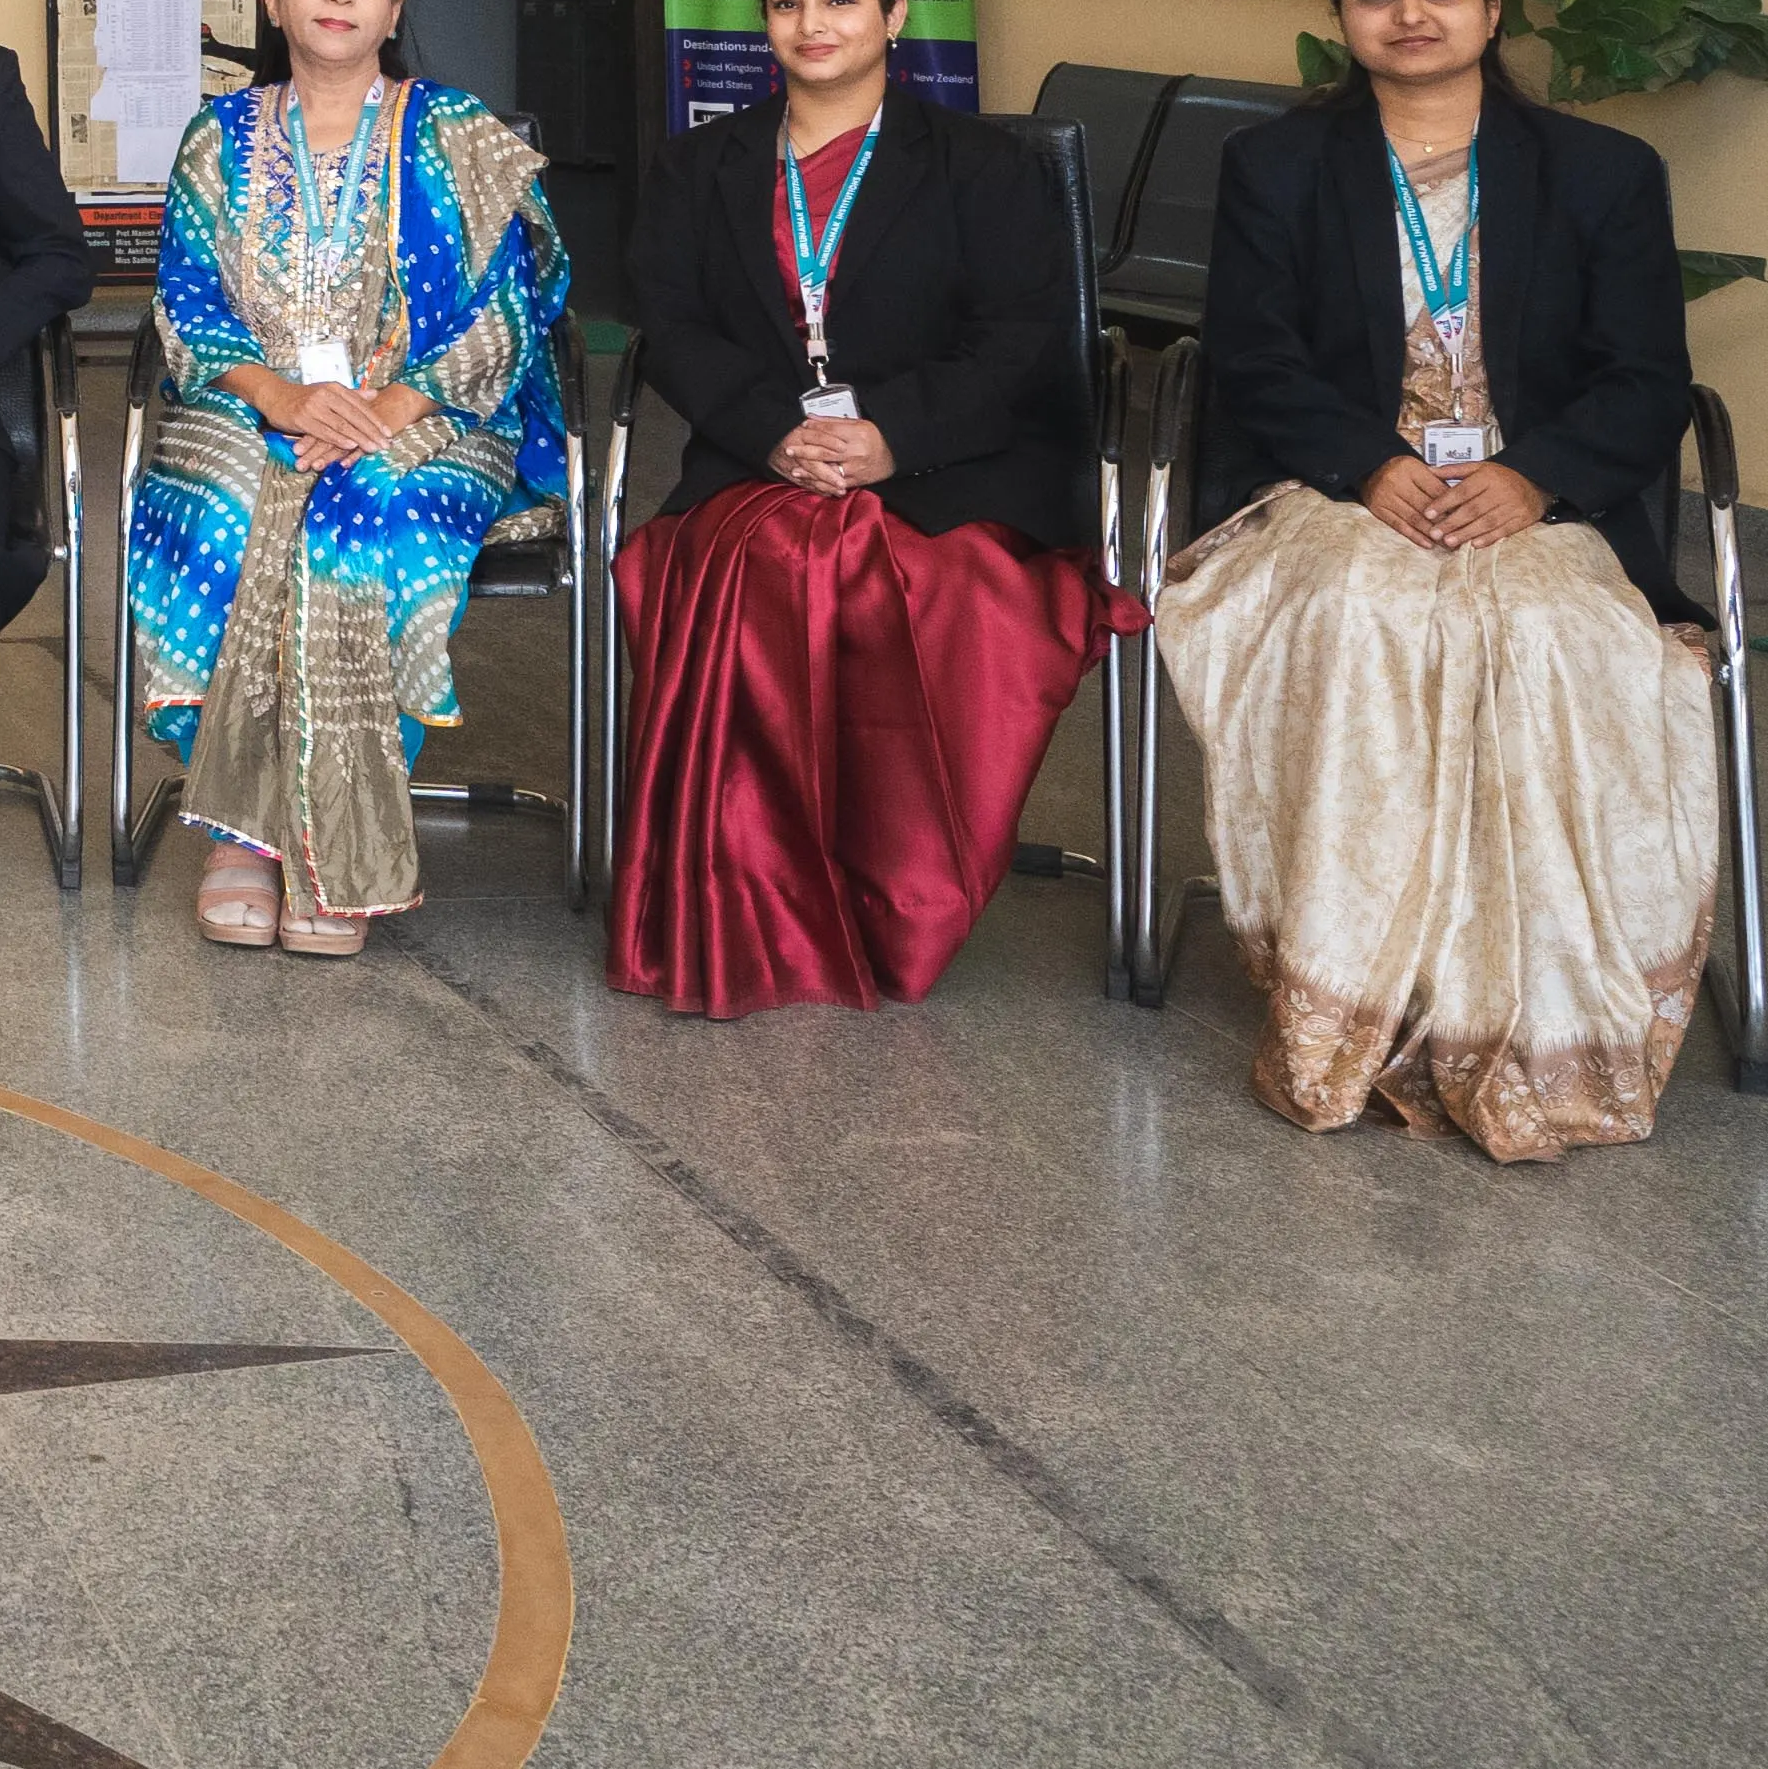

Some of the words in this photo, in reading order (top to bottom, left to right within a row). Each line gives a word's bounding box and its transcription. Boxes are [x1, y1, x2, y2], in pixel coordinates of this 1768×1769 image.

[683, 39, 747, 52] Destinations
[749, 43, 768, 52] and
[696, 61, 723, 72] United
[725, 64, 763, 75] Kingdom
[697, 79, 723, 89] United
[725, 81, 753, 90] States
[913, 72, 934, 83] New
[936, 73, 974, 84] Zealand
[819, 220, 842, 268] GURUNANAK
[835, 177, 861, 220] INSTITUTIONS
[855, 150, 873, 178] NAGPUR
[1399, 189, 1424, 238] INSTITUTIONS
[1414, 240, 1438, 292] GURUNANAK
